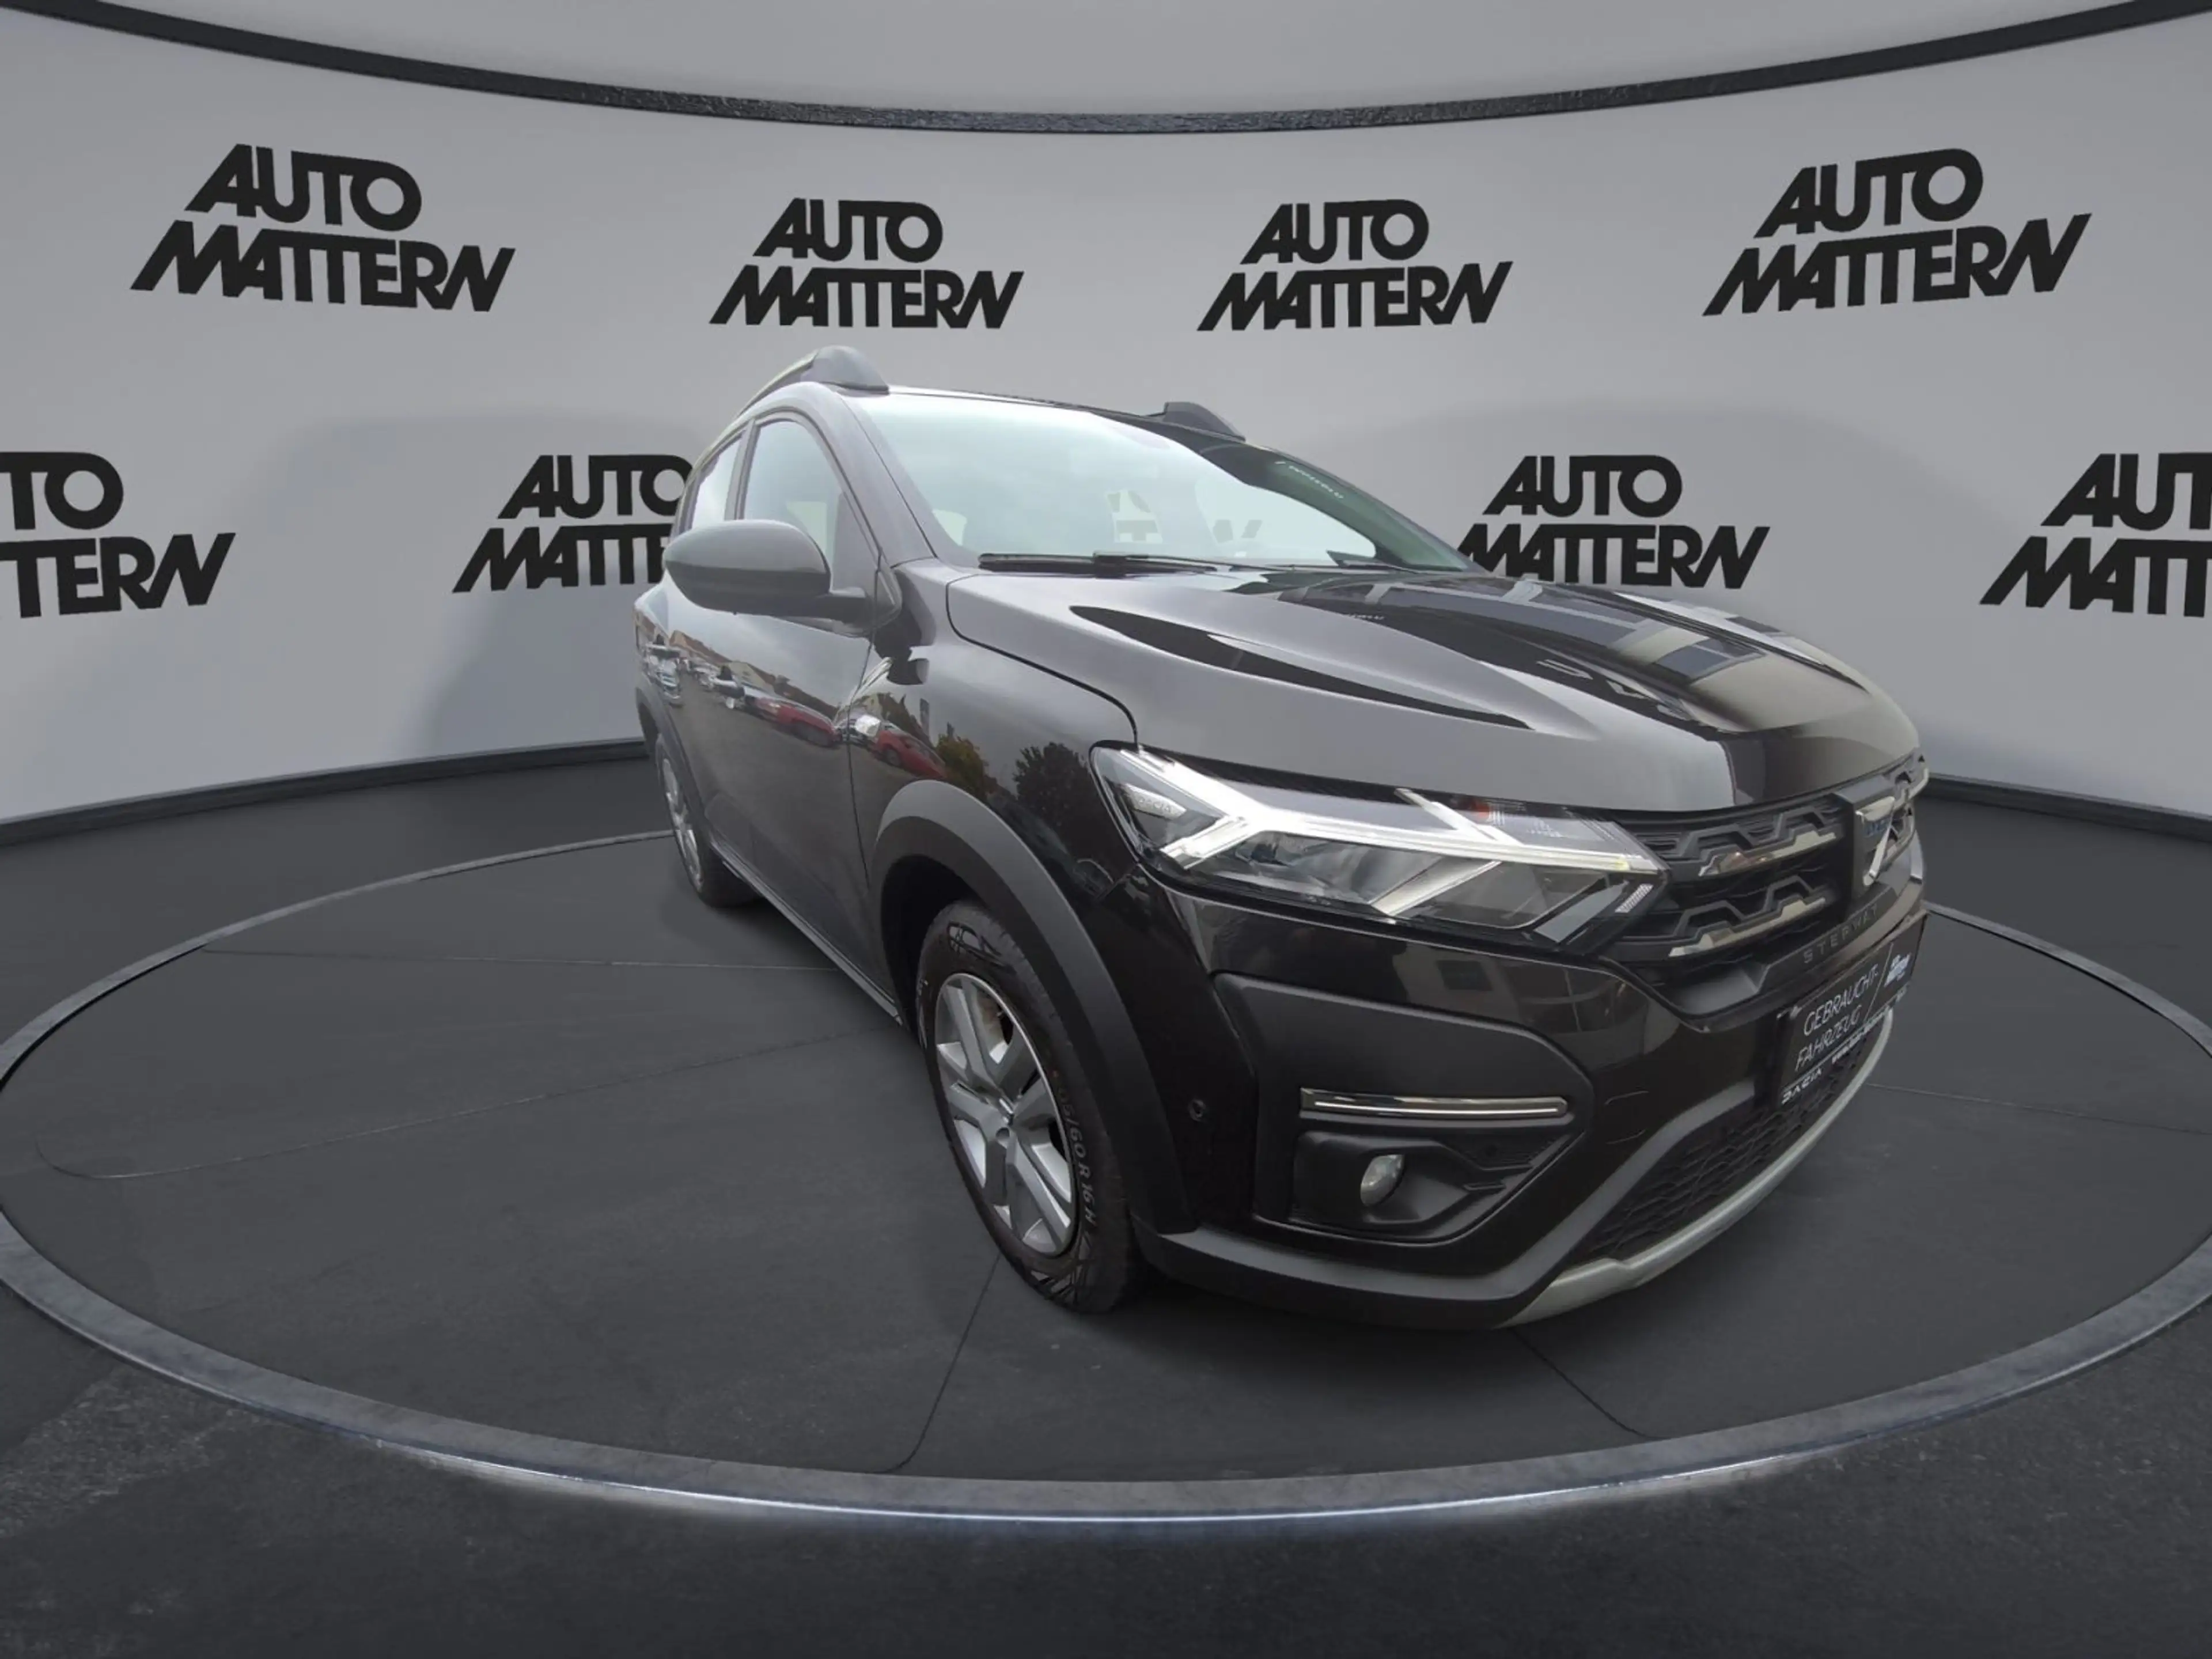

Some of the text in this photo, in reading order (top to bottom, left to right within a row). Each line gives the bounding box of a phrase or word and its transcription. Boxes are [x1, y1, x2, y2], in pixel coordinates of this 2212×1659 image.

[185, 143, 422, 232] AUTO
[1754, 149, 1983, 238] AUTO
[753, 198, 943, 263] AUTO
[1240, 199, 1429, 264] AUTO
[1703, 213, 2092, 316] MATTERN
[130, 219, 516, 312] MATTERN
[710, 264, 1024, 328] MATTERN
[1197, 261, 1513, 331] MATTERN
[498, 454, 693, 519] AUTO
[1483, 455, 1682, 518] AUTO
[0, 532, 236, 618] TERN
[1457, 524, 1770, 589] MATTERN
[1794, 1004, 1863, 1073] FAHRZEUG
